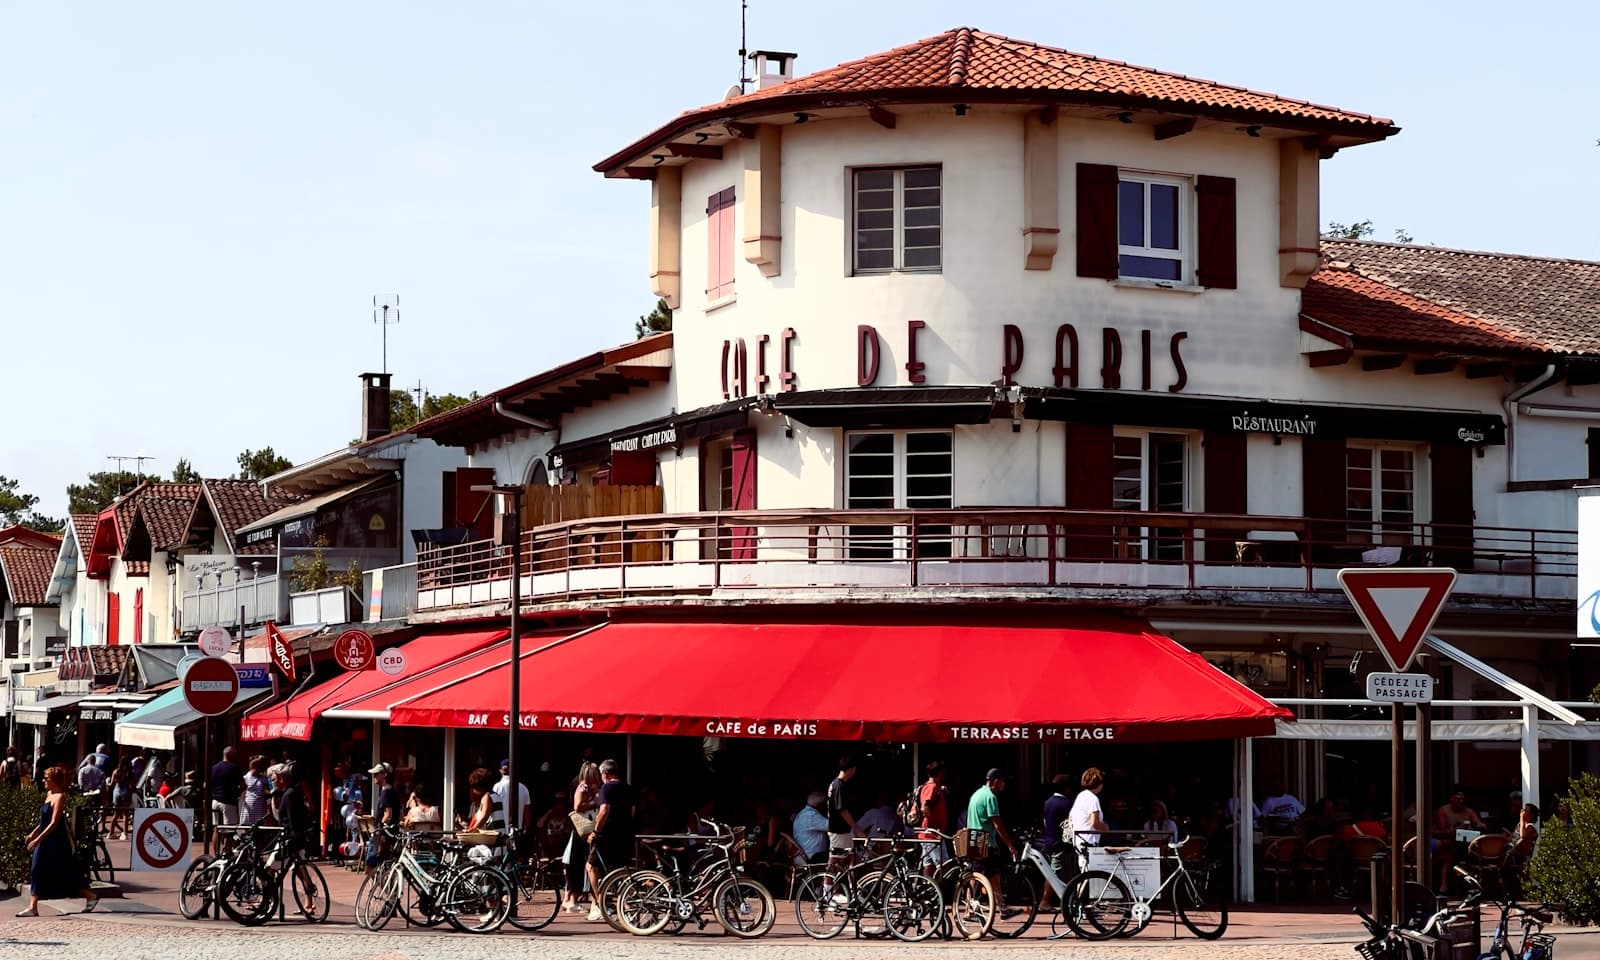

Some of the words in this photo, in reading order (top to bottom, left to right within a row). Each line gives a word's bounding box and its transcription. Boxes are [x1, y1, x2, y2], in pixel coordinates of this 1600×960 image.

[721, 327, 796, 400] CAFE
[857, 320, 926, 386] DE
[1002, 323, 1188, 393] PARIS
[1232, 416, 1316, 434] RESTAURANT
[1458, 428, 1484, 442] Carlsberg
[271, 632, 292, 670] TABAC
[344, 656, 364, 667] Vape
[383, 656, 403, 665] CBD
[1374, 677, 1409, 687] CÉDEZ
[1415, 679, 1427, 688] LE
[1376, 688, 1425, 698] PASSAGE
[468, 713, 488, 725] BAR
[503, 714, 538, 727] SACK
[555, 716, 594, 729] TAPAS
[706, 721, 741, 734] CAFE
[747, 723, 767, 734] de
[773, 723, 817, 736] PARIS
[951, 727, 1029, 739] TERRASSE
[1037, 727, 1057, 740] 1er
[1063, 728, 1114, 740] ETAGE
